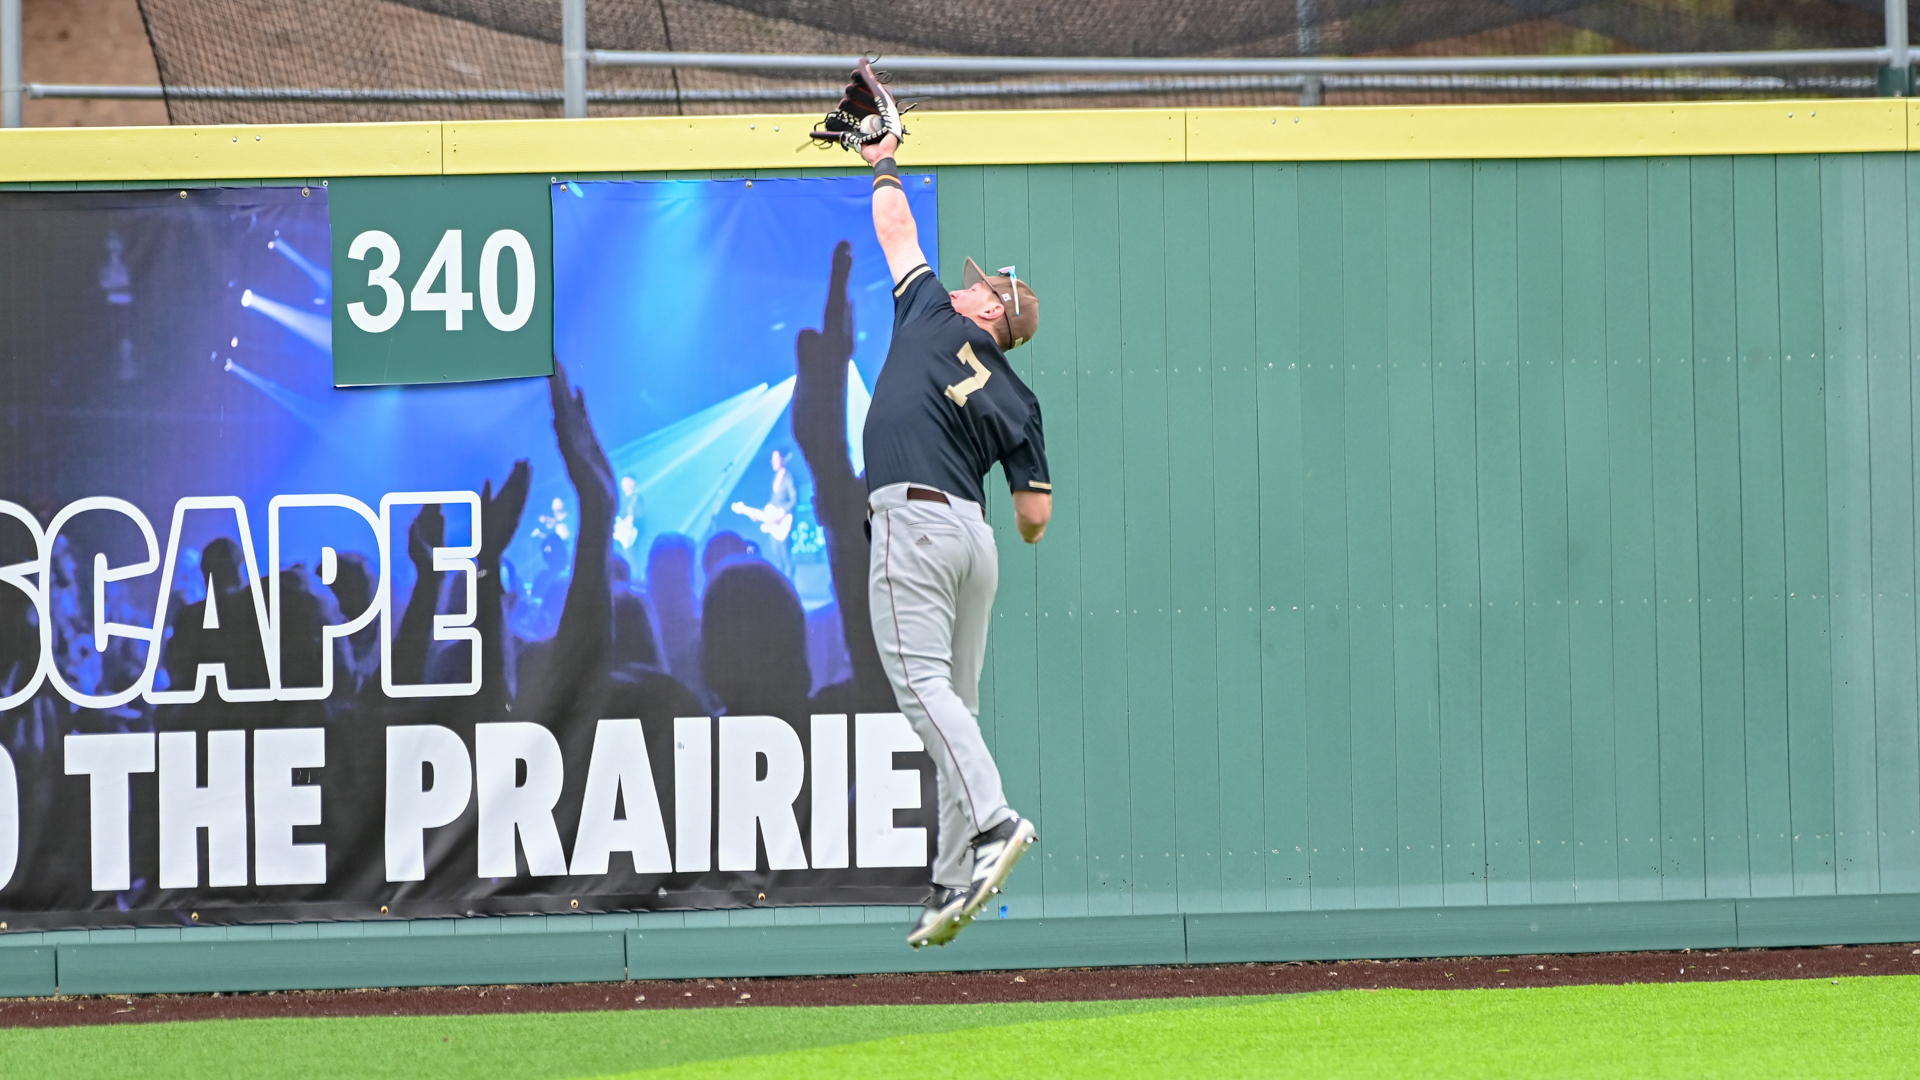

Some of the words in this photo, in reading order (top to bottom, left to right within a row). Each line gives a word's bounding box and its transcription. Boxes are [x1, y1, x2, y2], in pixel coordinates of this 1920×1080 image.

[346, 229, 536, 333] 340
[944, 341, 992, 407] 7
[64, 727, 327, 892] THE
[385, 712, 928, 882] PRAIRIE
